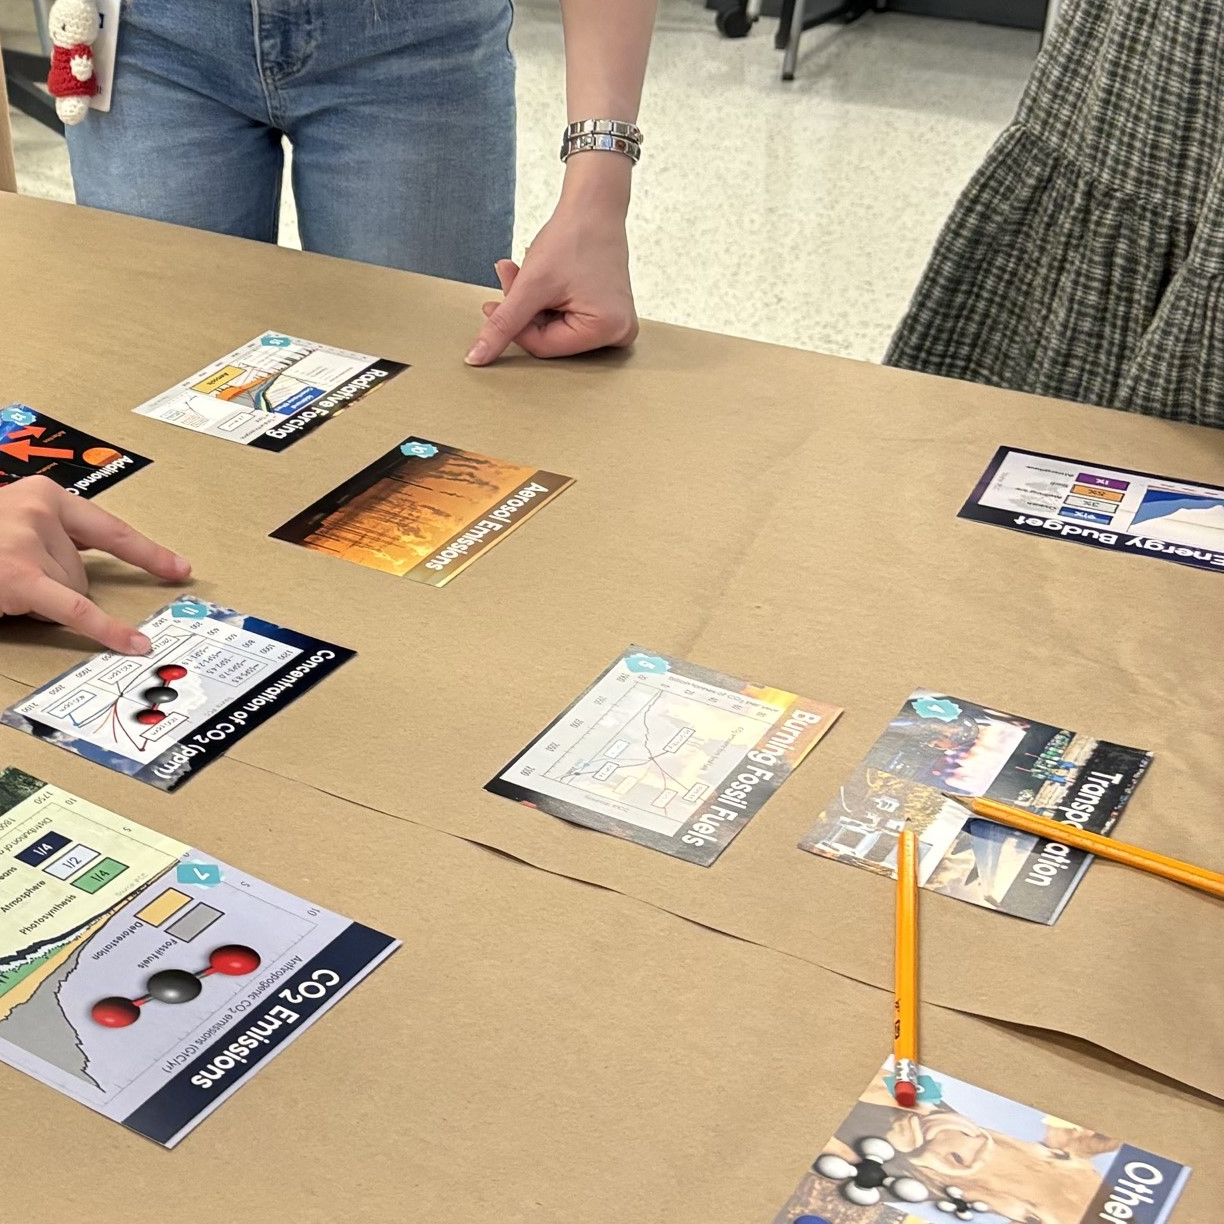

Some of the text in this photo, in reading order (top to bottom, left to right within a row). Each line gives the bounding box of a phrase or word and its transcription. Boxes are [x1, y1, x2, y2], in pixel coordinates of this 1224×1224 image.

[317, 368, 388, 408] Radiative
[262, 405, 329, 439] Forcing
[72, 454, 133, 490] Additional
[424, 481, 548, 570] Aerosol Emissions
[1013, 514, 1118, 545] Budget
[242, 649, 335, 711] Concentration
[227, 710, 248, 725] of
[152, 744, 205, 780] (ppm)
[680, 708, 821, 846] Burning Fossil Fuels
[32, 790, 53, 804] 1750
[9, 816, 53, 845] Distribution
[1023, 771, 1125, 888] Transpoation
[2, 843, 13, 851] of
[32, 842, 53, 855] 1/4
[61, 856, 82, 869] 1/2
[89, 869, 110, 882] 1/4
[192, 867, 210, 880] 7
[0, 879, 46, 913] Atmosphere
[306, 907, 320, 916] 10
[18, 894, 77, 935] Photosynthesis
[90, 920, 144, 960] Deforestation
[136, 938, 178, 969] Fossil fuels
[246, 954, 303, 1000] Anthropogenic
[193, 1013, 233, 1045] emissions
[160, 1043, 199, 1073] (GtC/yr)
[190, 1004, 300, 1088] Emissions
